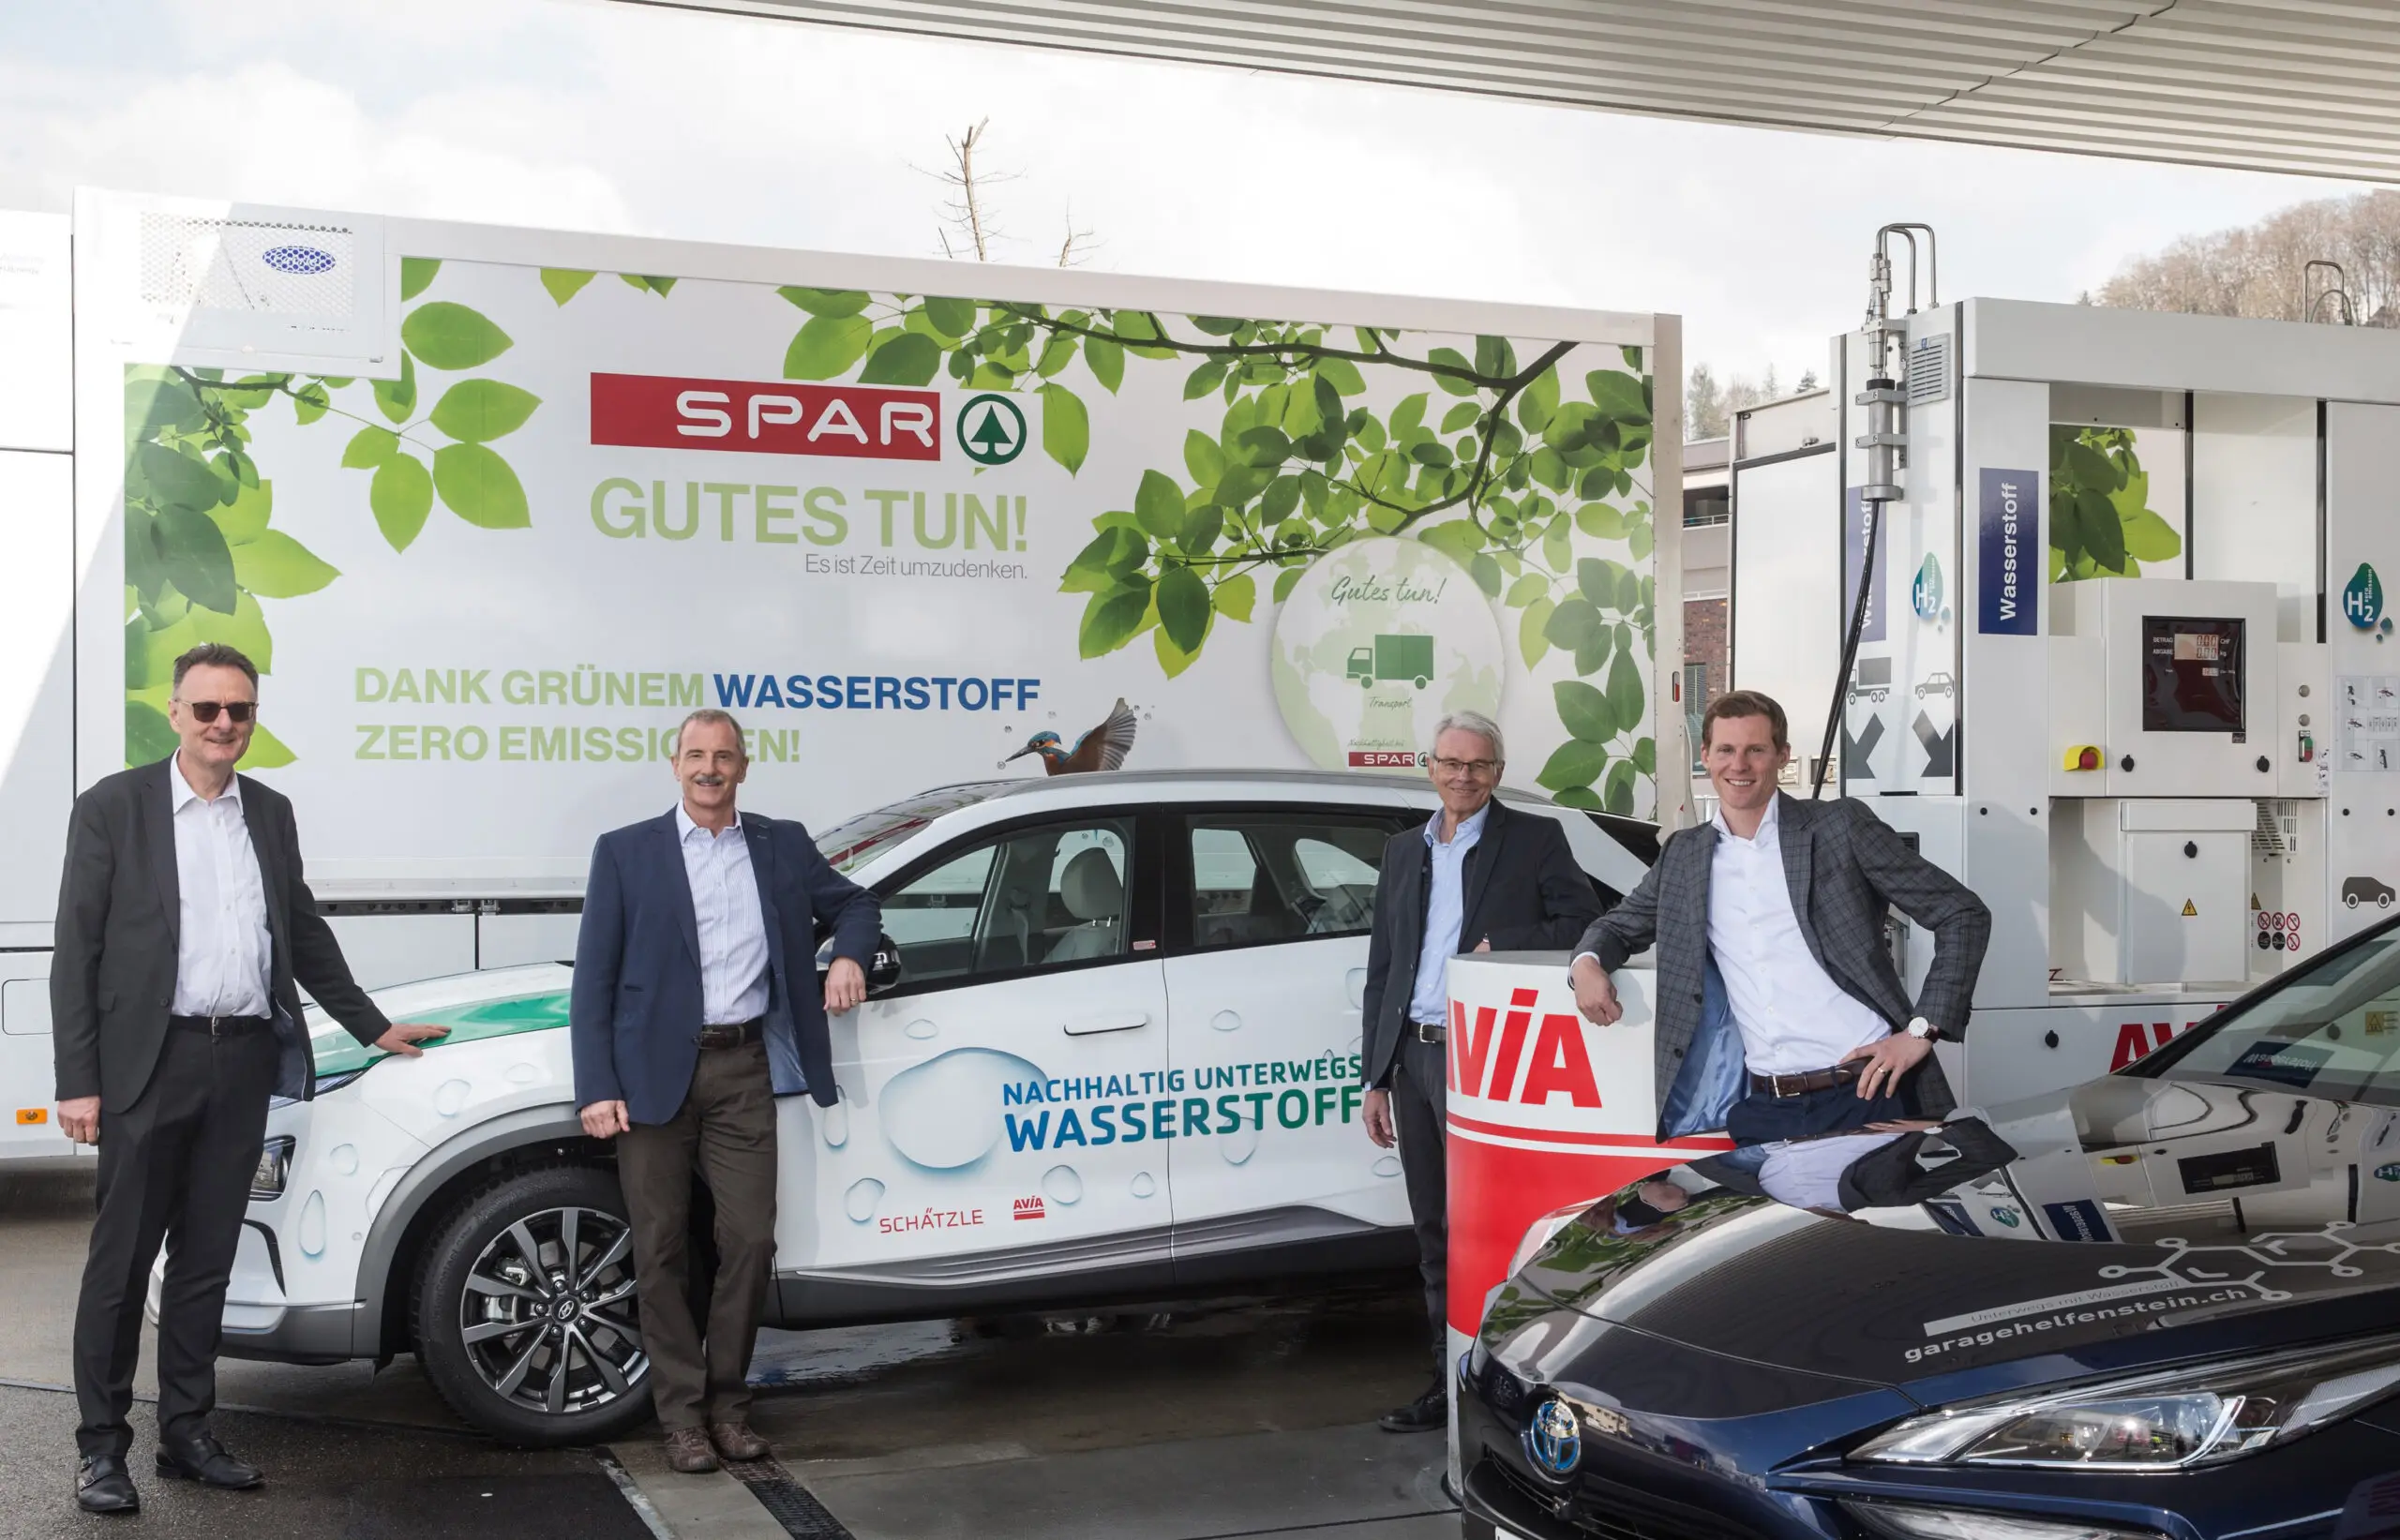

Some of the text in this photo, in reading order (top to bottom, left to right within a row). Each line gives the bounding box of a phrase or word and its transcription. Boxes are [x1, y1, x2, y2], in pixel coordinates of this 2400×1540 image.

[676, 390, 934, 448] SPAR
[590, 477, 1028, 552] GUTES TUN!
[805, 553, 1028, 579] Es ist Zeit umzudenken.
[2000, 482, 2018, 621] Wasserstoff
[1331, 575, 1448, 606] Gutes tun!
[2348, 591, 2374, 622] H2
[354, 664, 1041, 711] DANK GRÜNEM WASSERSTOFF
[355, 725, 801, 762] ZERO EMISSIN!
[1363, 754, 1415, 765] SPAR
[1003, 1055, 1362, 1106] NACHHALTIG UNTERWEGS
[1005, 1084, 1363, 1153] WASSERSTOFF
[879, 1207, 984, 1233] SCHÄTZLE
[1904, 1289, 2248, 1363] garagehelfenstein.ch
[1971, 1301, 2053, 1323] Unterwegs
